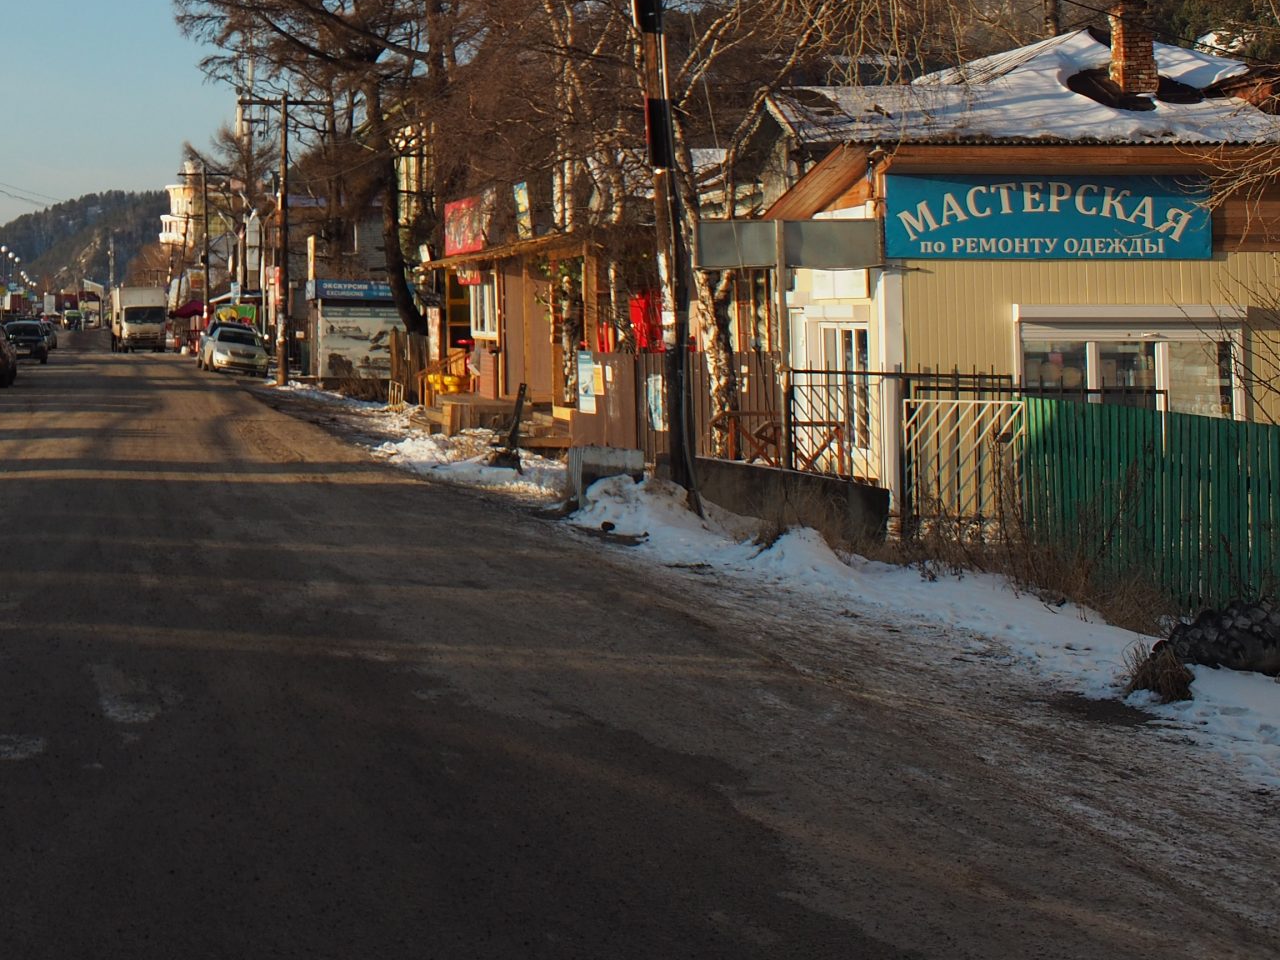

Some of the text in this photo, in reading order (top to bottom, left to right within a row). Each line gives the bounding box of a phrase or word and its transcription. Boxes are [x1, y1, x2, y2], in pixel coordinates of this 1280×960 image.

[897, 181, 1193, 242] МАСТЕРСКАЯ
[920, 237, 1166, 257] по РЕМОНТУ ОДЕЖДЫ
[322, 282, 369, 290] ЭКСКУРСИИ
